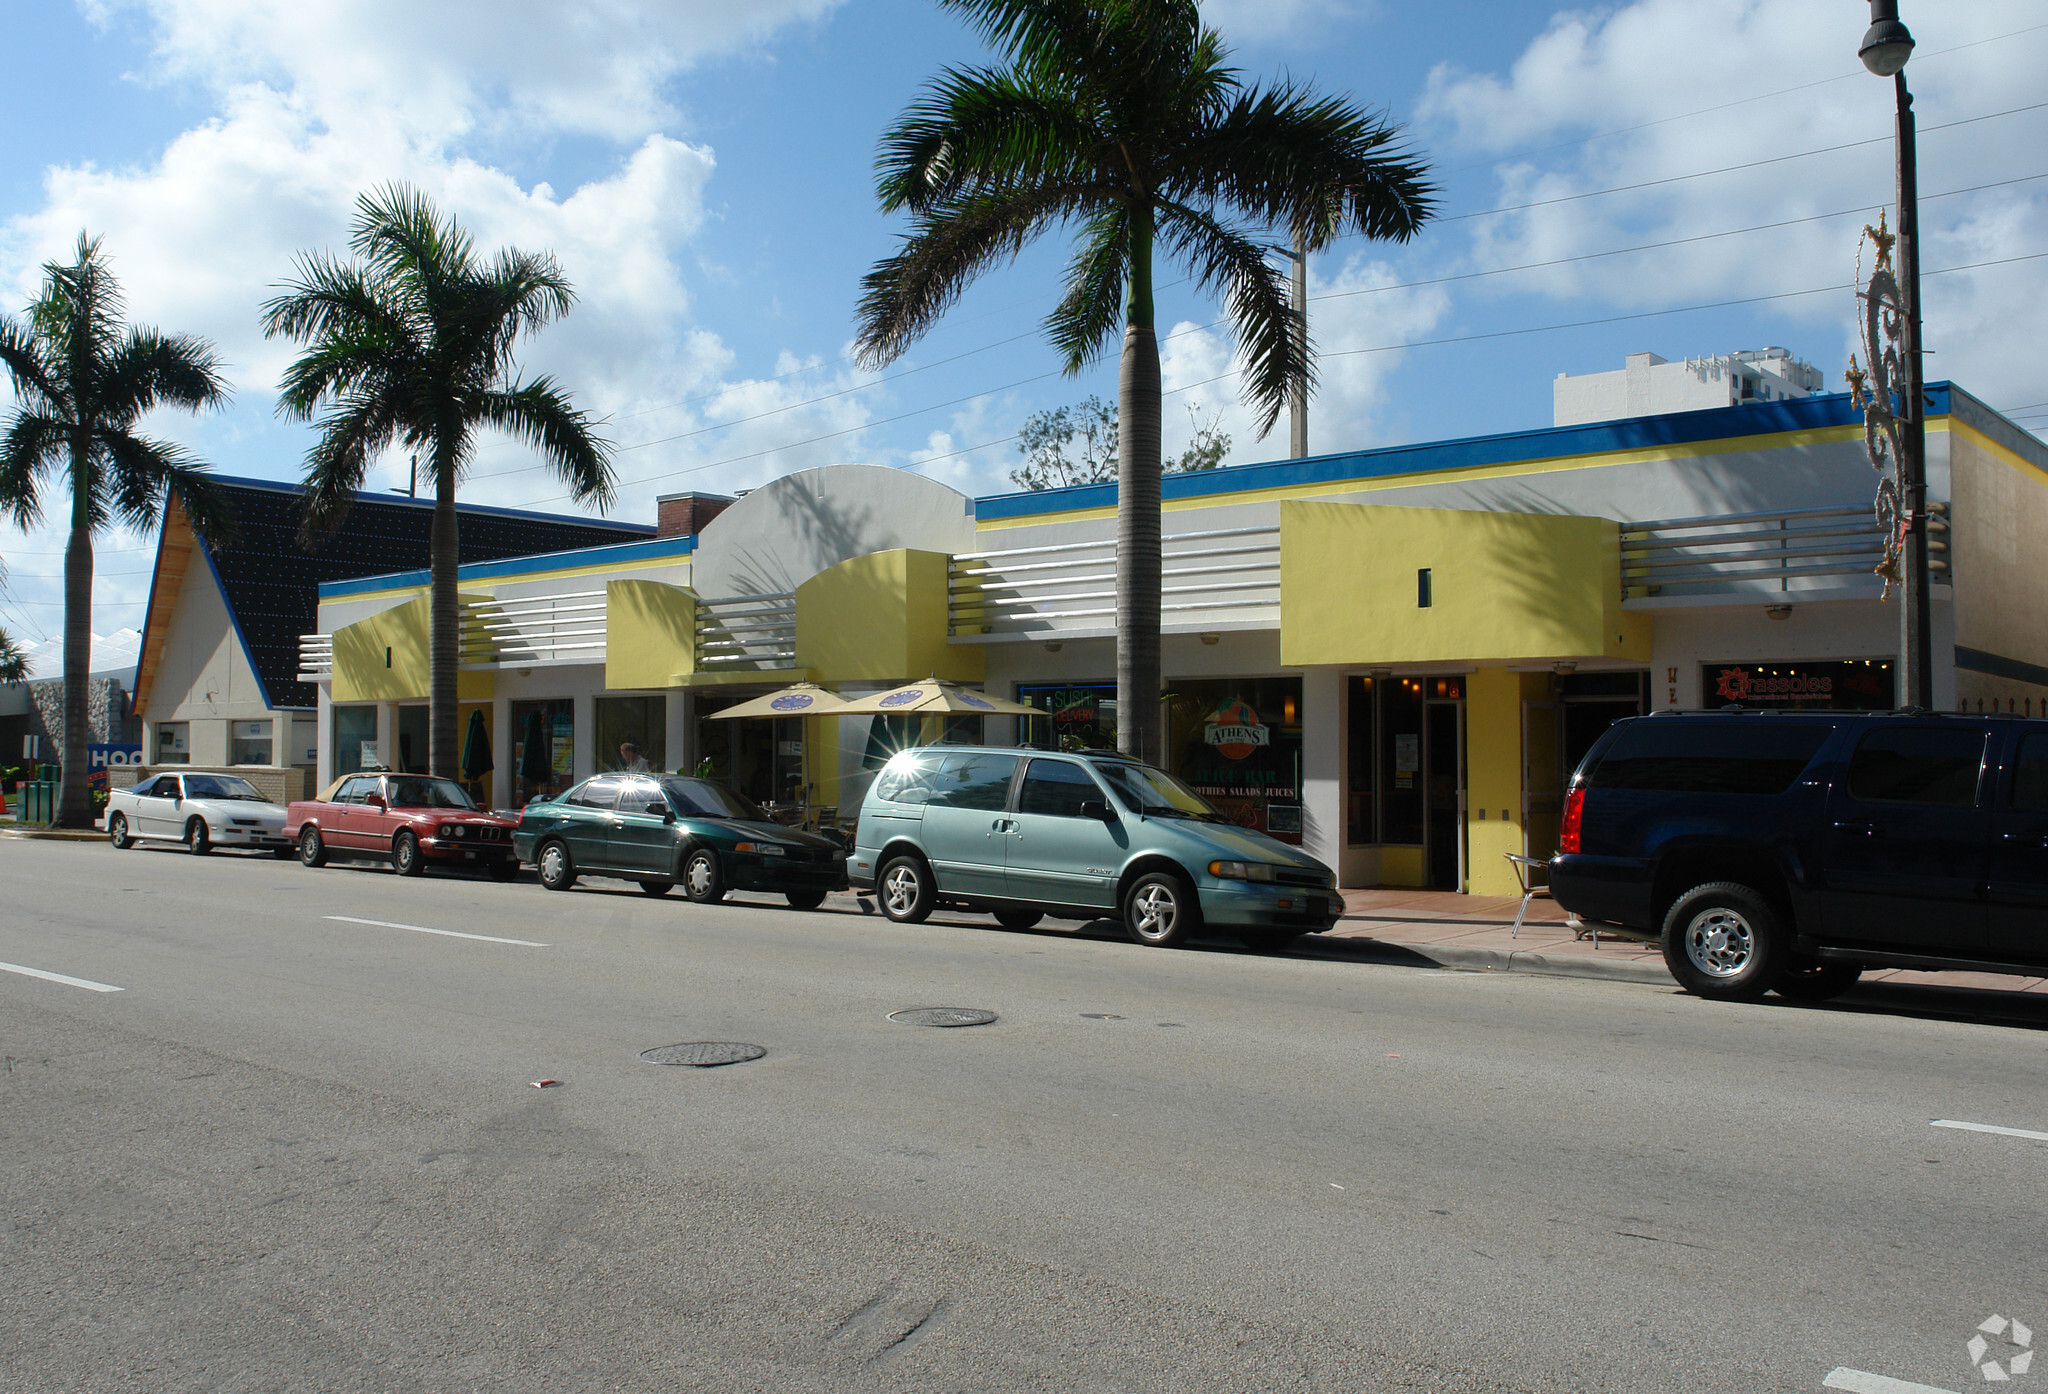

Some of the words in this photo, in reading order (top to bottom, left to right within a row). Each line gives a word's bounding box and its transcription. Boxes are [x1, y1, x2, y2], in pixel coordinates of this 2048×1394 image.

[1725, 673, 1833, 693] Girassoles
[1055, 690, 1093, 708] SUSHI
[1056, 710, 1094, 722] DELIVERY
[1212, 727, 1260, 744] ATHENS
[1195, 769, 1240, 783] JUICE
[1244, 769, 1277, 784] BAR
[1191, 786, 1226, 796] OTHIES
[1229, 787, 1261, 797] SALADS
[1264, 787, 1294, 797] JUICES
